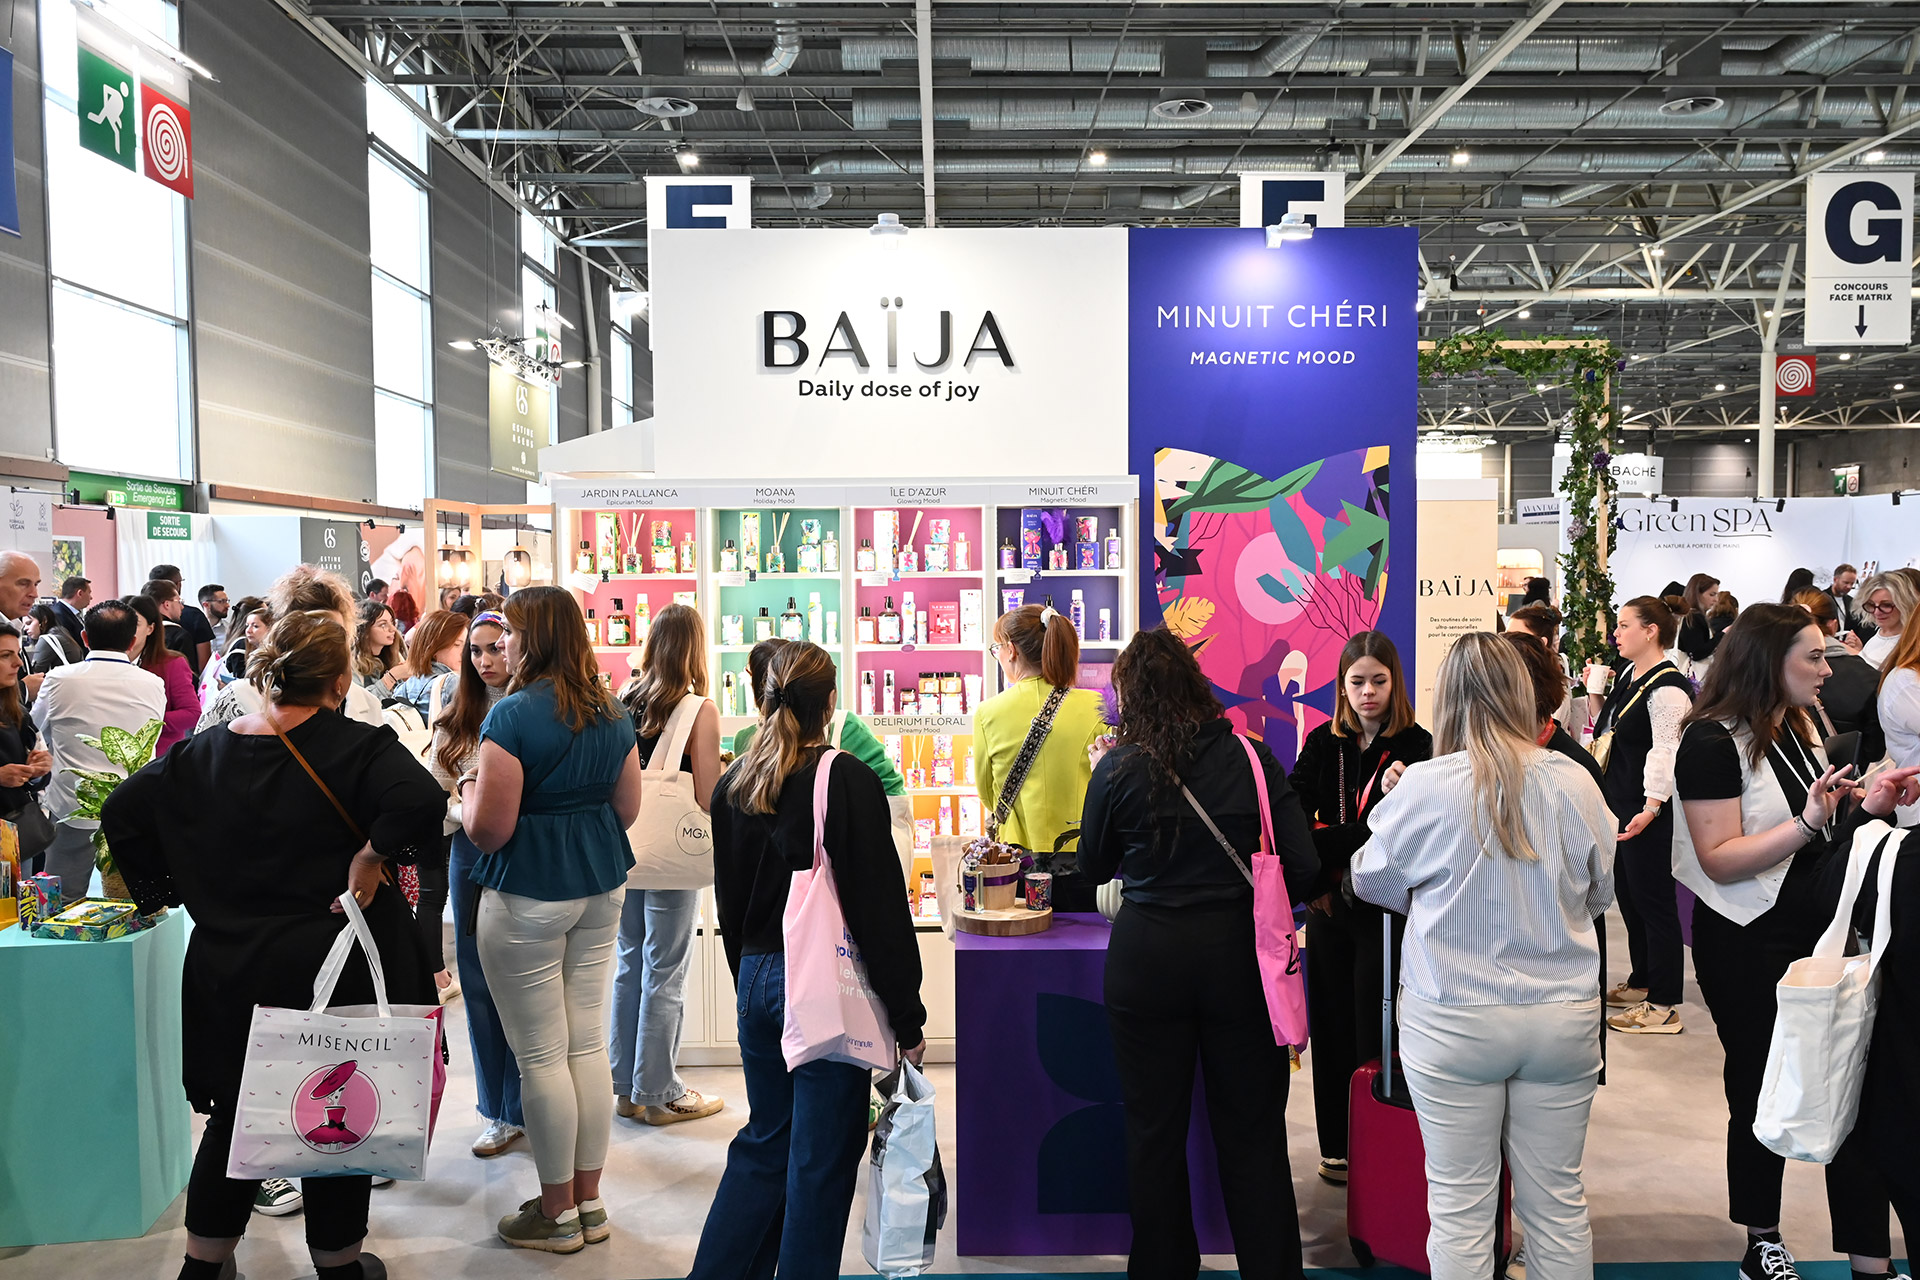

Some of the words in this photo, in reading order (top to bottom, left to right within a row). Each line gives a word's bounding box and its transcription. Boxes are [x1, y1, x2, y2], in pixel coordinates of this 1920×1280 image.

[1825, 181, 1902, 264] G
[1834, 283, 1888, 291] CONCOURS
[1157, 305, 1274, 328] MINUIT
[1287, 299, 1387, 328] CHÉRI
[763, 296, 1015, 367] BAÏJA
[1190, 351, 1290, 365] MAGNETIC
[1296, 351, 1356, 365] MOOD
[799, 380, 854, 400] Daily
[861, 381, 912, 397] dose
[919, 381, 941, 397] of
[945, 381, 980, 401] joy
[1612, 465, 1656, 477] BACHÉ
[126, 480, 144, 492] Sortie
[145, 483, 152, 493] de
[153, 483, 176, 495] Secours
[581, 489, 619, 498] JARDIN
[622, 489, 678, 497] PALLANCA
[755, 488, 795, 496] MOANA
[890, 487, 905, 496] ÎLE
[908, 487, 947, 496] D'AZUR
[1028, 487, 1064, 495] MINUIT
[1067, 485, 1098, 495] CHÉRI
[133, 492, 165, 506] Emergency
[166, 495, 176, 506] Exit
[160, 516, 180, 526] SORTIE
[1620, 508, 1706, 532] Green
[1713, 508, 1773, 532] SPA
[153, 527, 161, 536] DE
[162, 527, 187, 537] SECOURS
[1420, 575, 1494, 596] BAÏJA
[873, 718, 921, 727] DELIRIUM
[925, 717, 966, 726] FLORAL
[682, 827, 709, 839] MGA
[298, 1033, 391, 1051] MISENCIL
